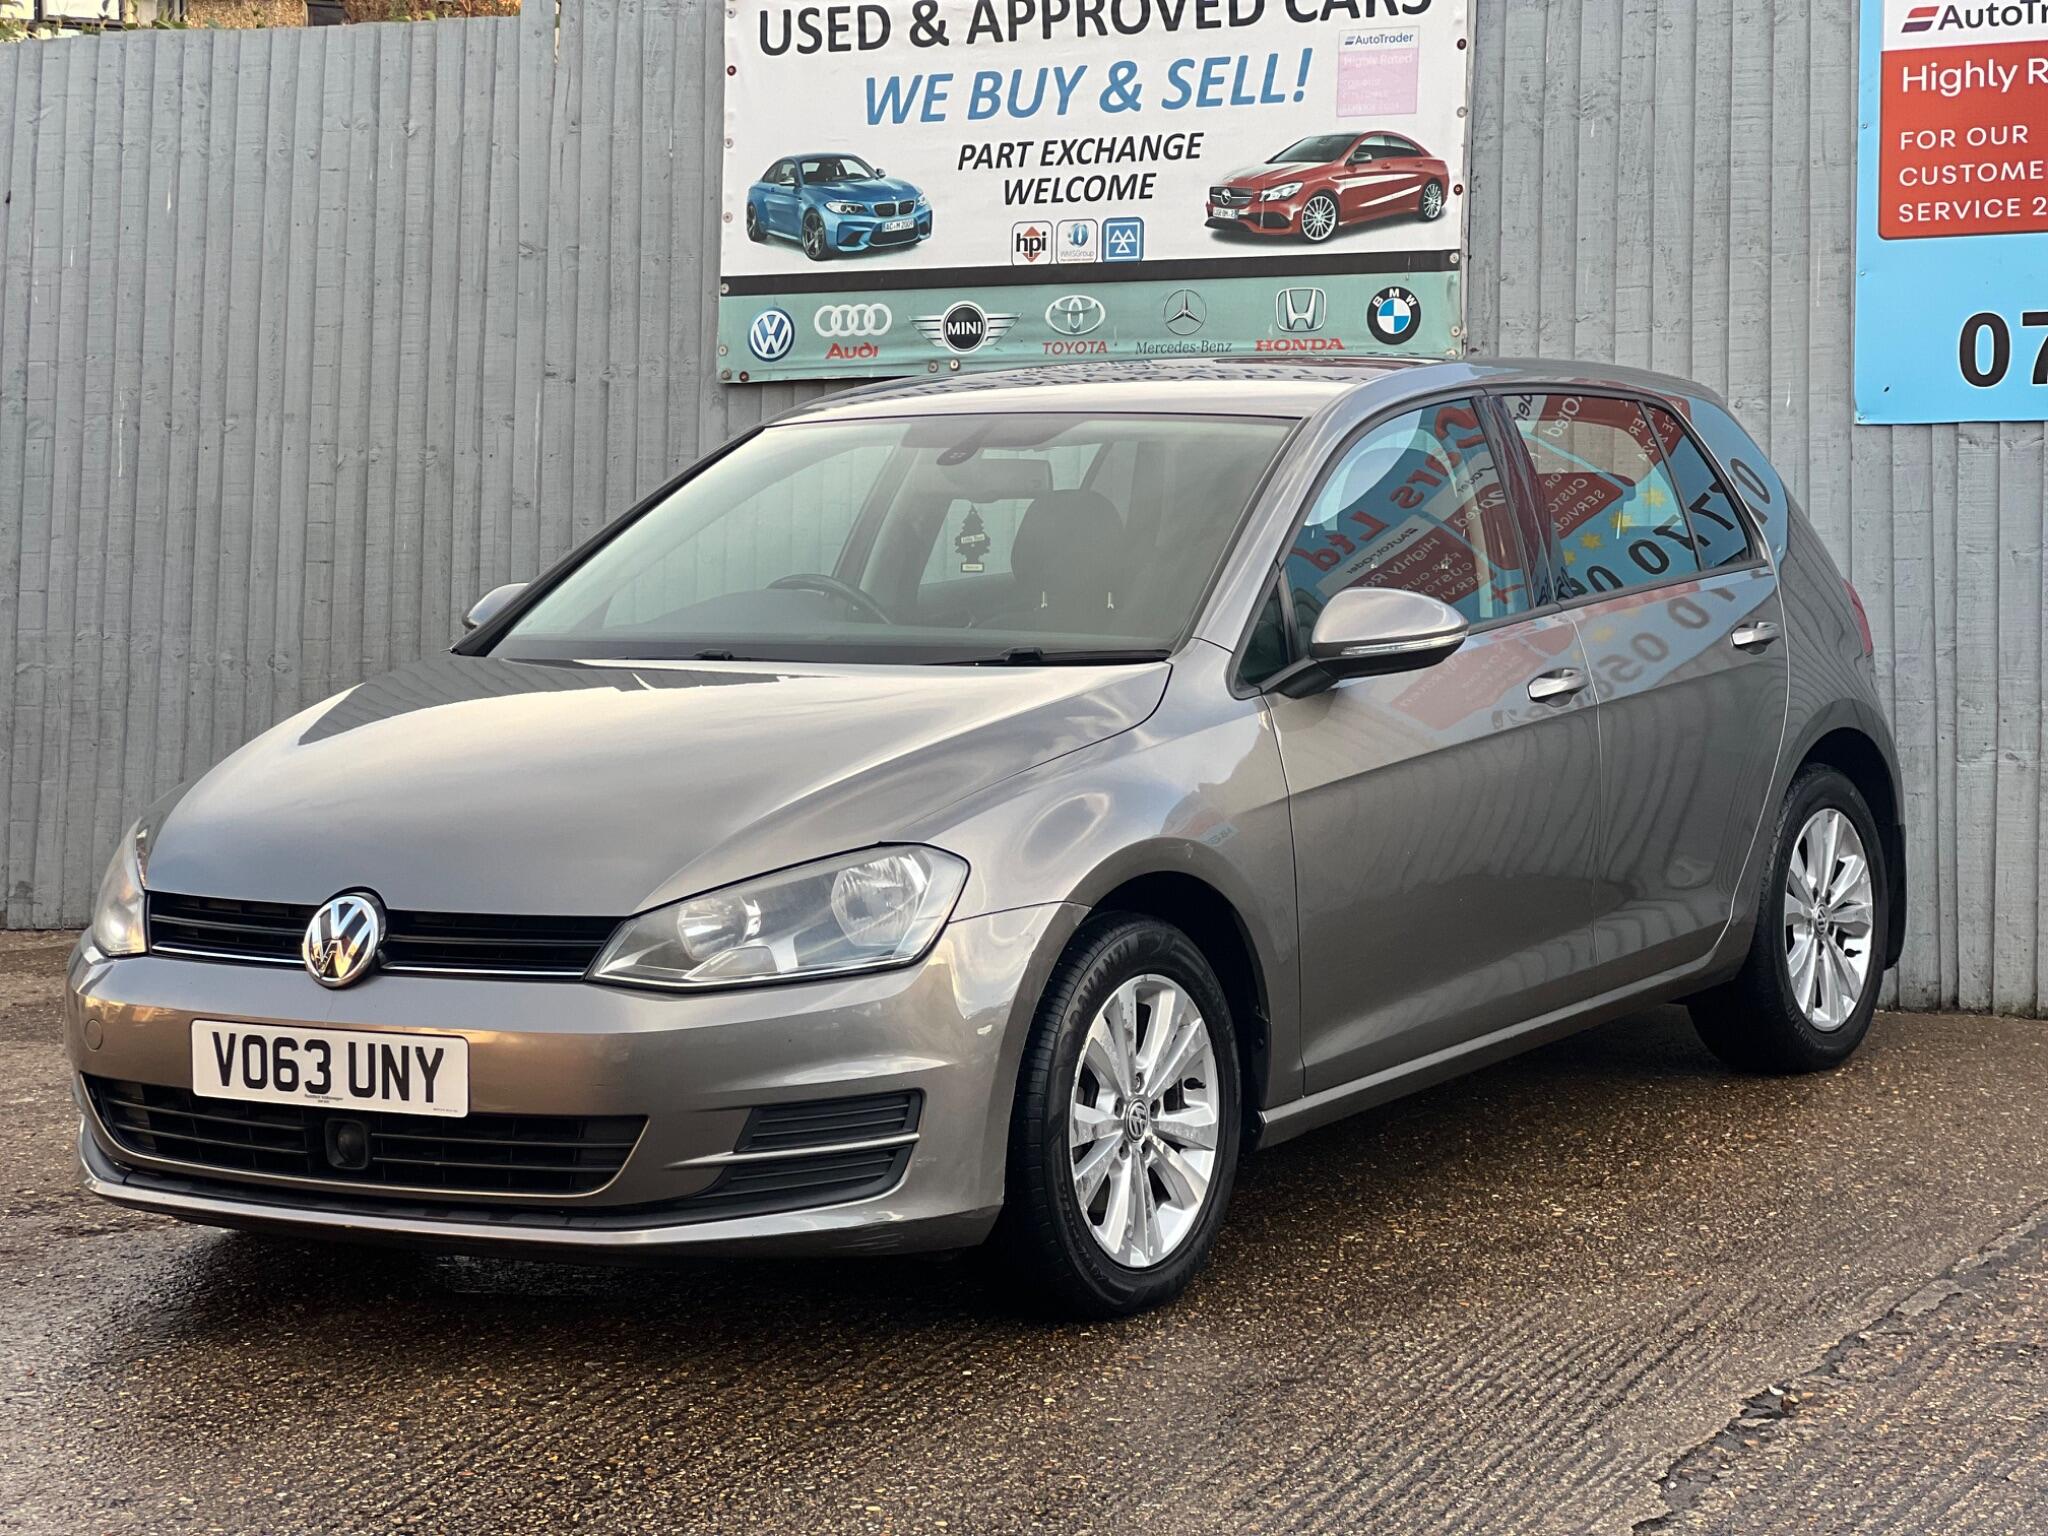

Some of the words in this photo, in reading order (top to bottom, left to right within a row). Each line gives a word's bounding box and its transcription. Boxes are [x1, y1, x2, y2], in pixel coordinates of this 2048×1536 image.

[759, 4, 892, 56] USED
[909, 0, 950, 48] &
[966, 0, 1264, 45] APPROVED
[866, 73, 954, 125] WE
[967, 65, 1088, 120] BUY
[1099, 60, 1142, 114] &
[1161, 47, 1313, 111] SELL!
[1902, 58, 2018, 97] Highly
[957, 140, 1034, 171] PART
[1039, 131, 1205, 167] EXCHANGE
[1900, 129, 1956, 151] FOR
[1966, 124, 2029, 147] OUR
[1002, 172, 1157, 207] WELCOME
[1898, 197, 2022, 224] SERVICE
[1016, 231, 1047, 258] hpi
[946, 321, 982, 336] MINI
[825, 341, 879, 360] Audi
[1042, 339, 1108, 356] TOYOTA
[1135, 339, 1233, 355] Mercedes-Benz
[1254, 337, 1345, 353] HONDA
[211, 1031, 331, 1095] VO63
[347, 1041, 445, 1103] UNY
